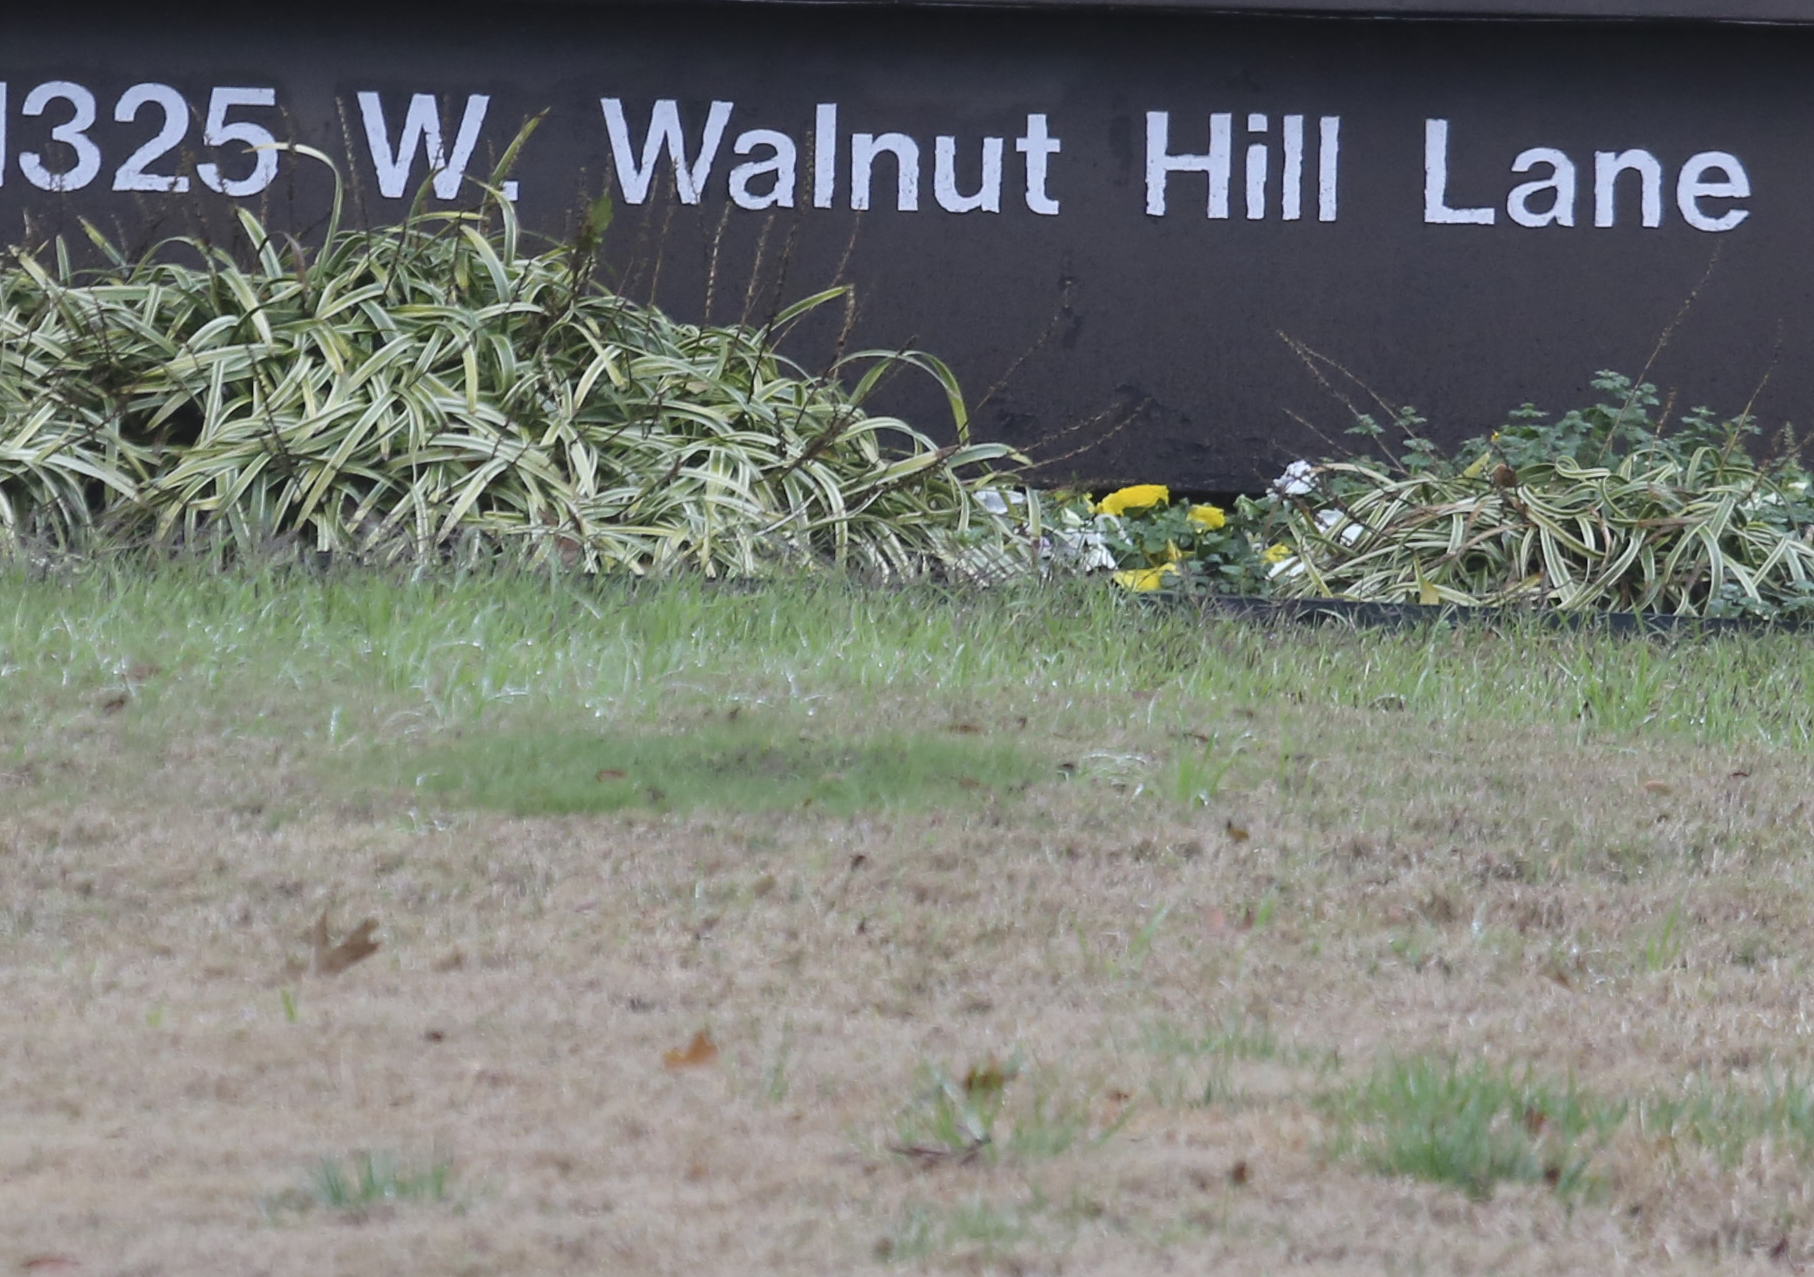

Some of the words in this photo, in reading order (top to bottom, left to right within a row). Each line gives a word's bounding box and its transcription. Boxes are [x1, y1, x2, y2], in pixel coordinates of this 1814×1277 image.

[356, 90, 522, 204] W.
[599, 97, 1062, 217] Walnut
[1142, 110, 1342, 223] Hill
[1422, 117, 1753, 234] Lane
